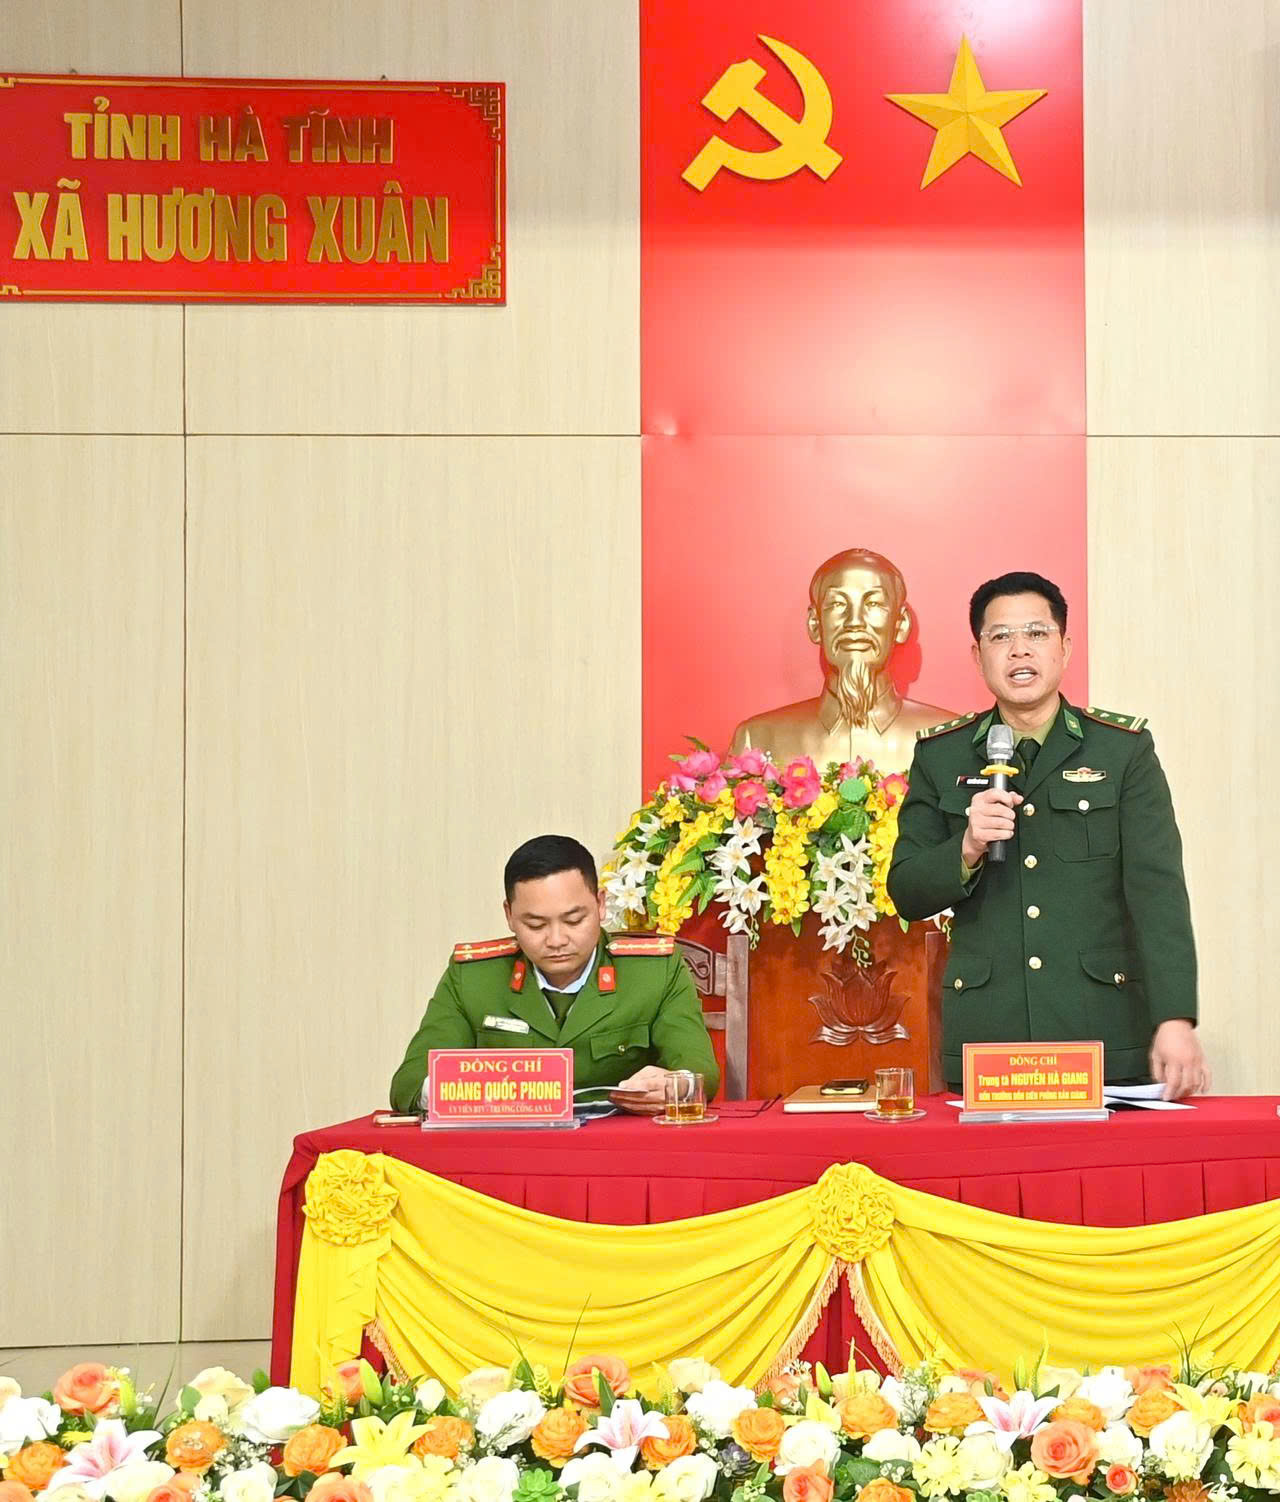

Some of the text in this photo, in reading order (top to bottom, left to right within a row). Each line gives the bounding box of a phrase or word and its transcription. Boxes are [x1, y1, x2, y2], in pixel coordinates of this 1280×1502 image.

[62, 94, 396, 165] TỈNH HÀ TĨNH
[12, 177, 450, 264] XÃ HƯƠNG XUÂN
[440, 1075, 561, 1102] HOÀNG QUỐC PHONG
[460, 1057, 542, 1072] ĐỒNG CHÍ
